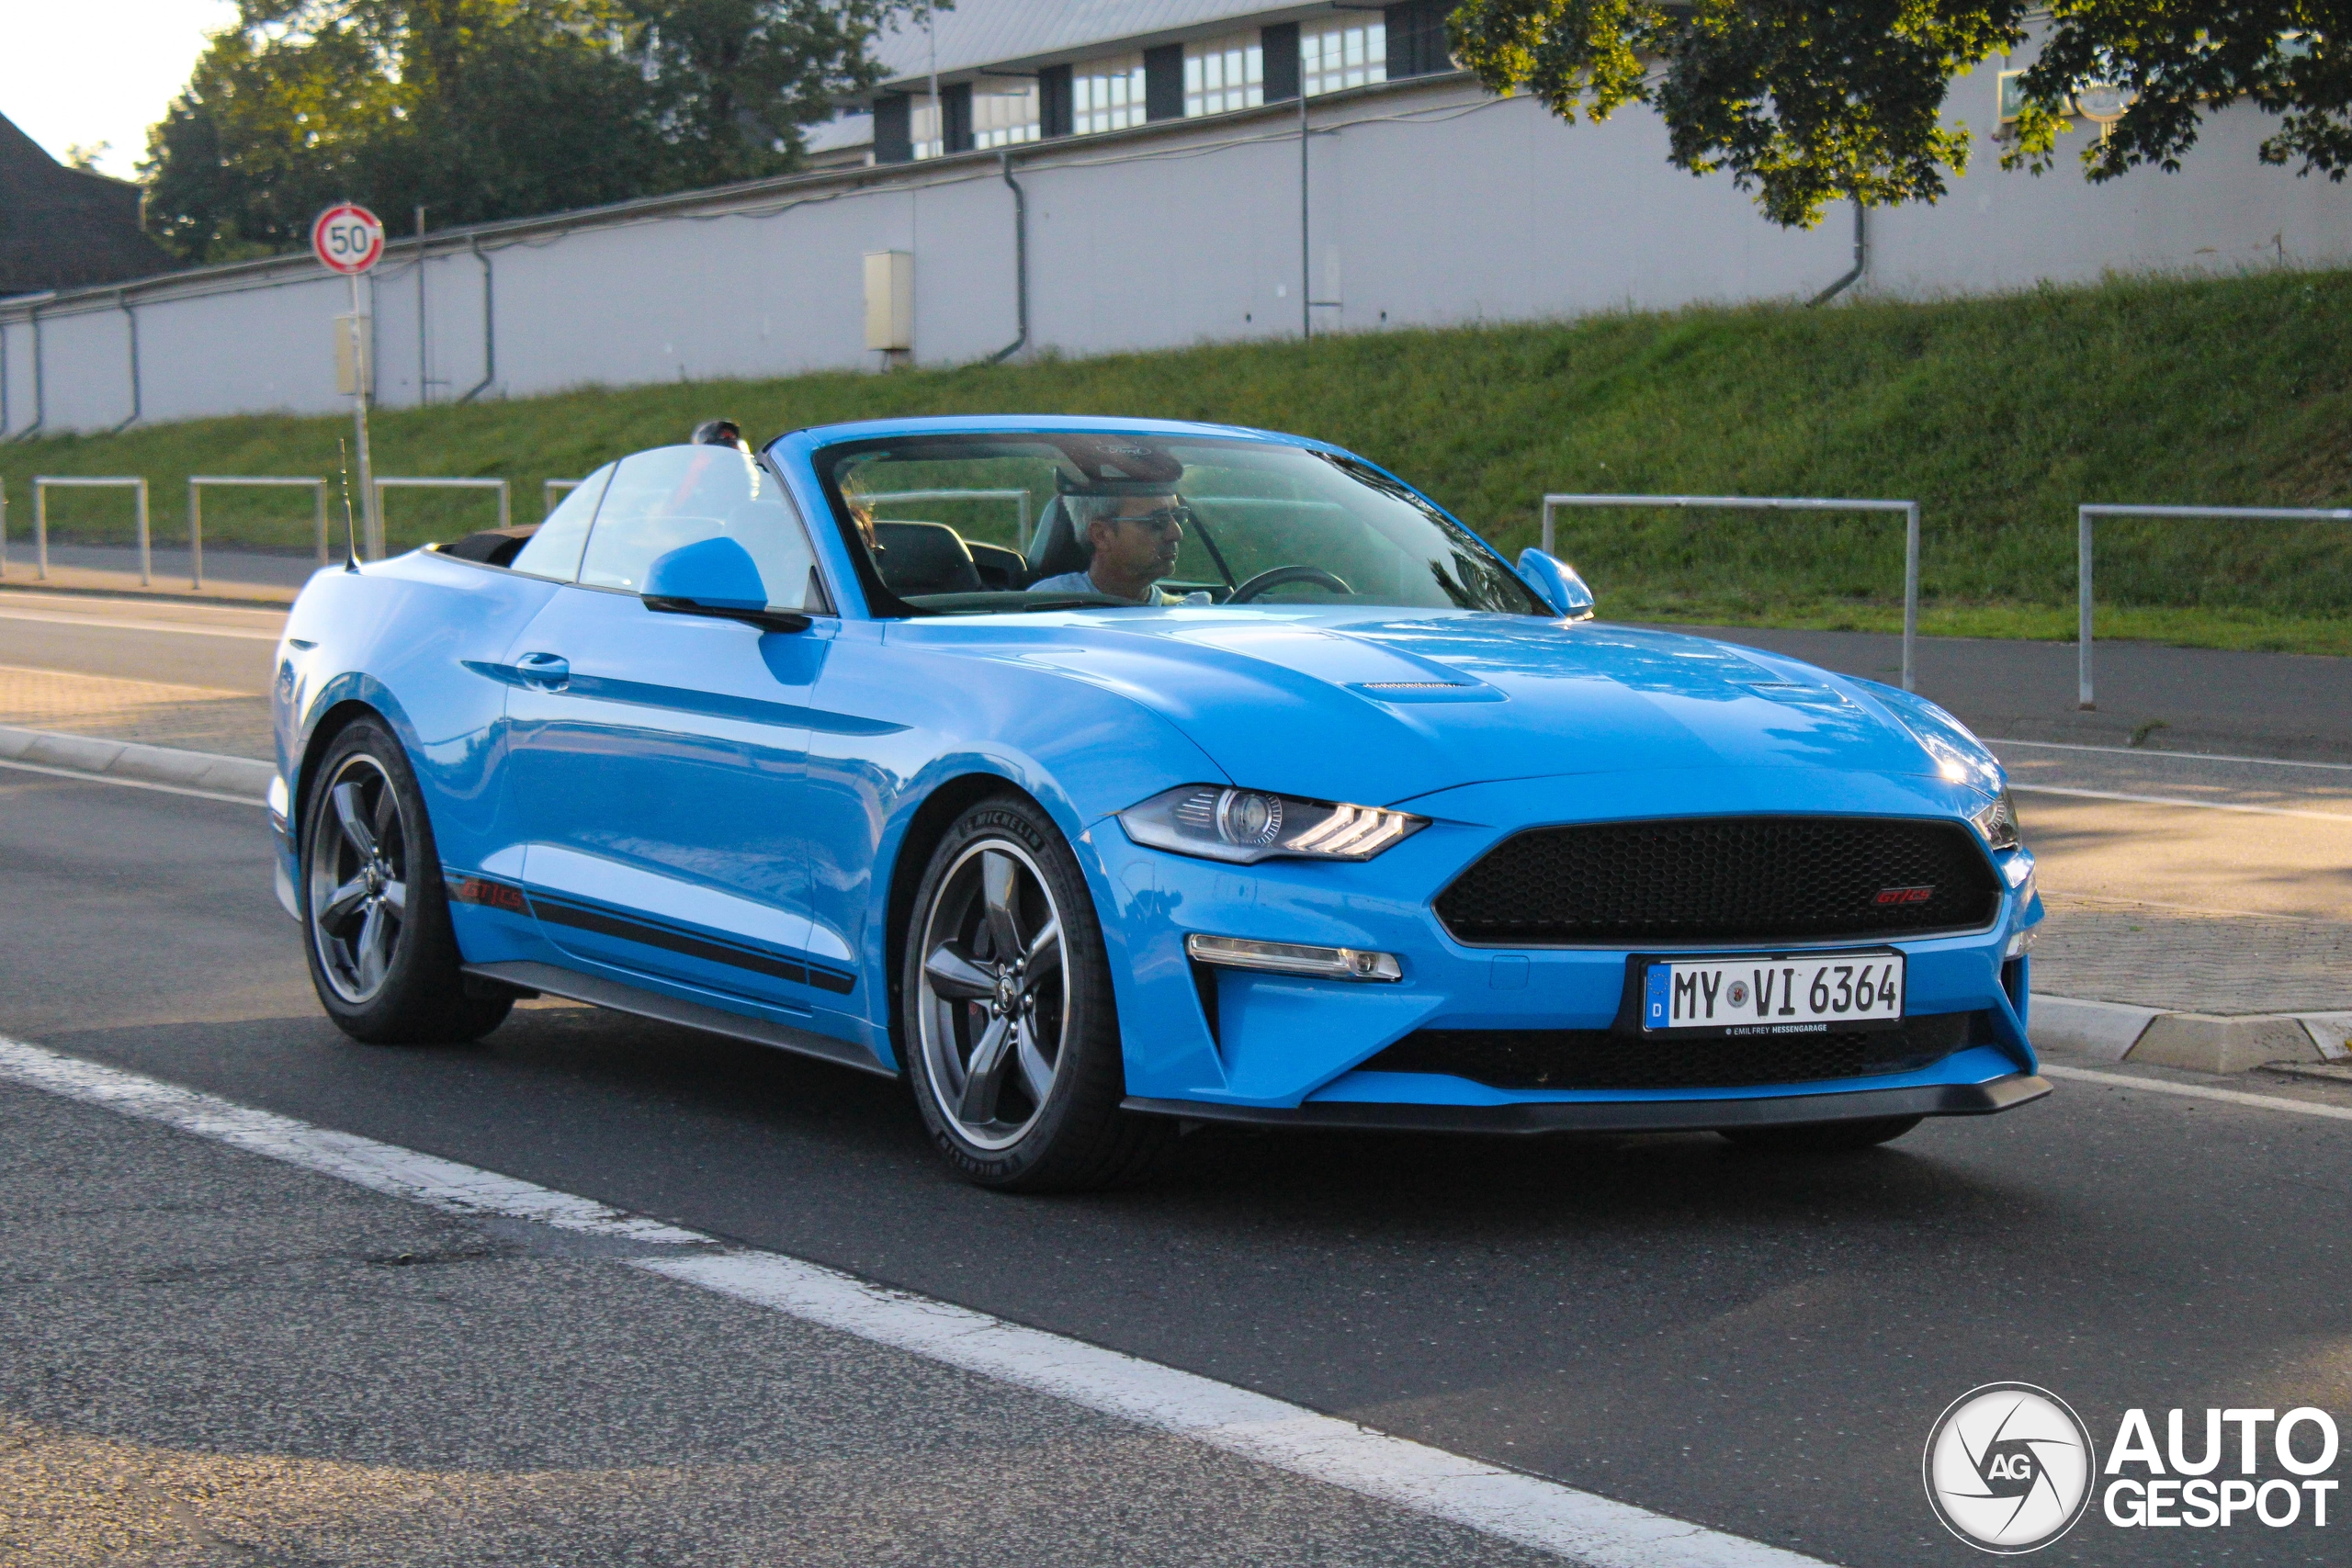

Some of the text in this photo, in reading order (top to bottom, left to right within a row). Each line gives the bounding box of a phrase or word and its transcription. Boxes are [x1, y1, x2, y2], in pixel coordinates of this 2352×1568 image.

[330, 225, 368, 254] 50
[1673, 964, 1897, 1019] MY VI 6364
[1653, 1003, 1661, 1017] D
[1734, 1024, 1827, 1035] EMIL FREY HESSENGARAGE
